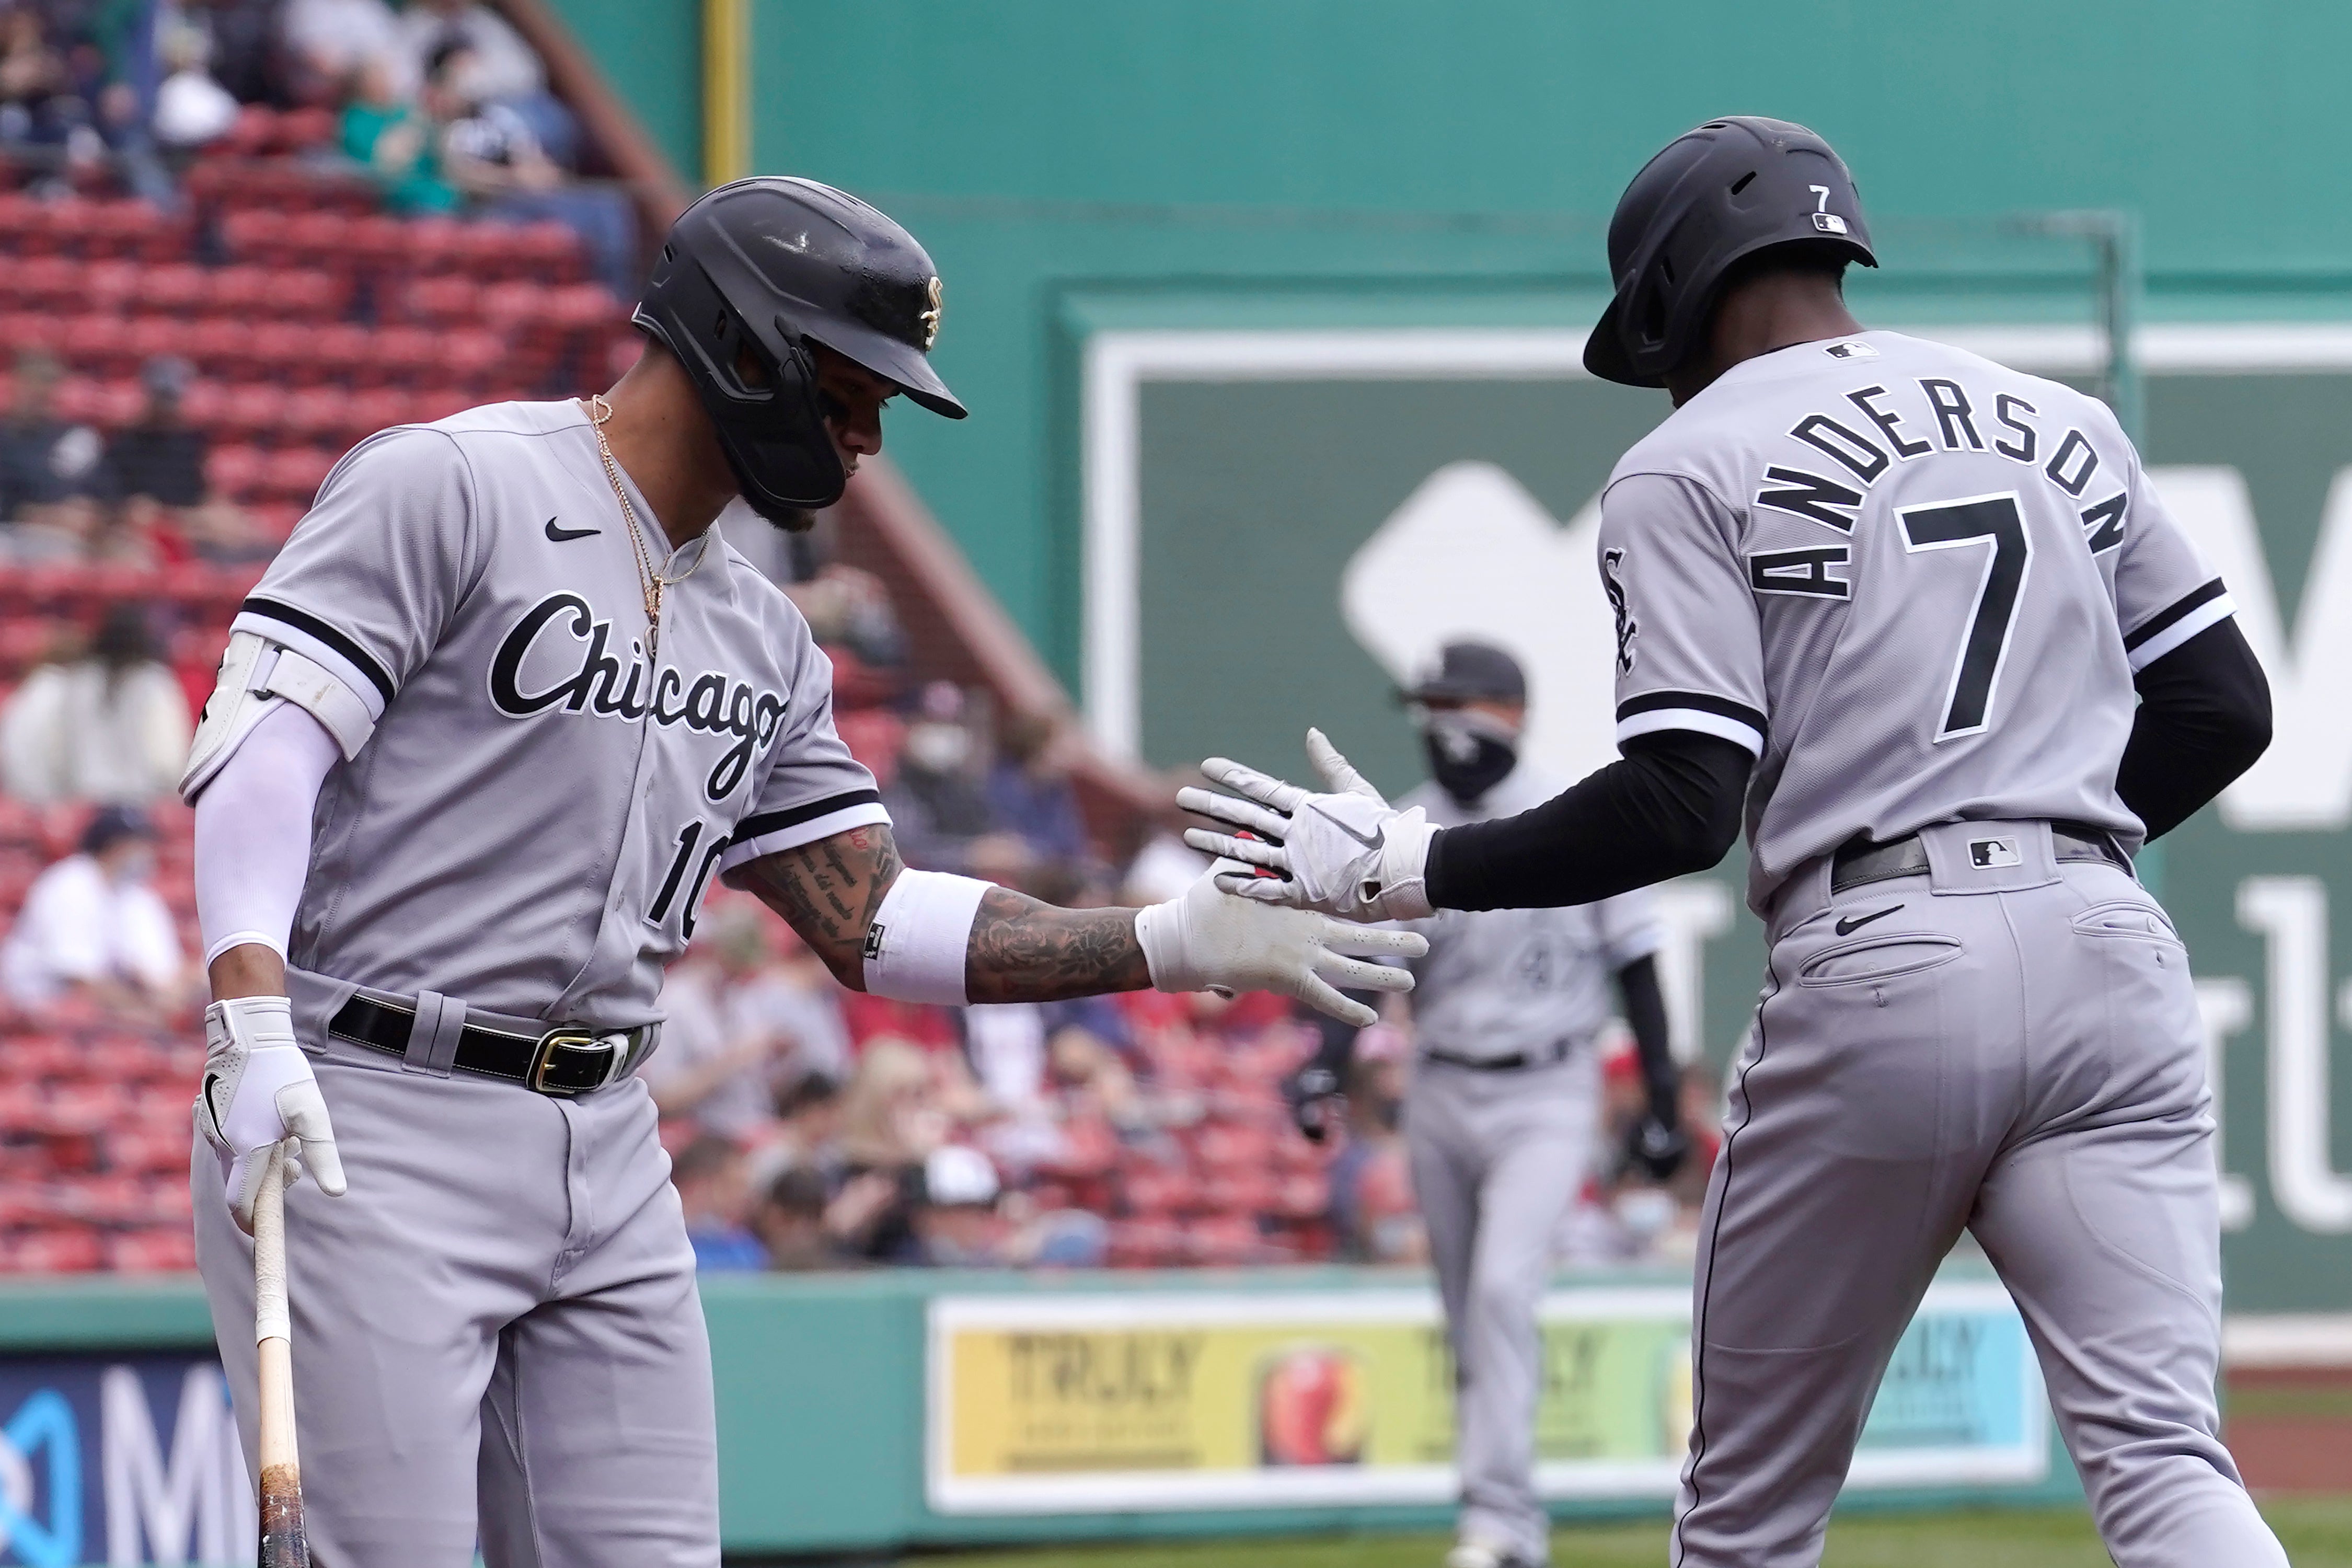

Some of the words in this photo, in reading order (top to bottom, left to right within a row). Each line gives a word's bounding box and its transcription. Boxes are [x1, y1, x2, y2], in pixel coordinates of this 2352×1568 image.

[1808, 184, 1830, 212] 7
[1748, 376, 2128, 601] ANDERSON
[487, 590, 790, 804] Chicago
[1893, 490, 2034, 744] 7
[642, 814, 734, 947] 10
[998, 1330, 1206, 1403] TRULY
